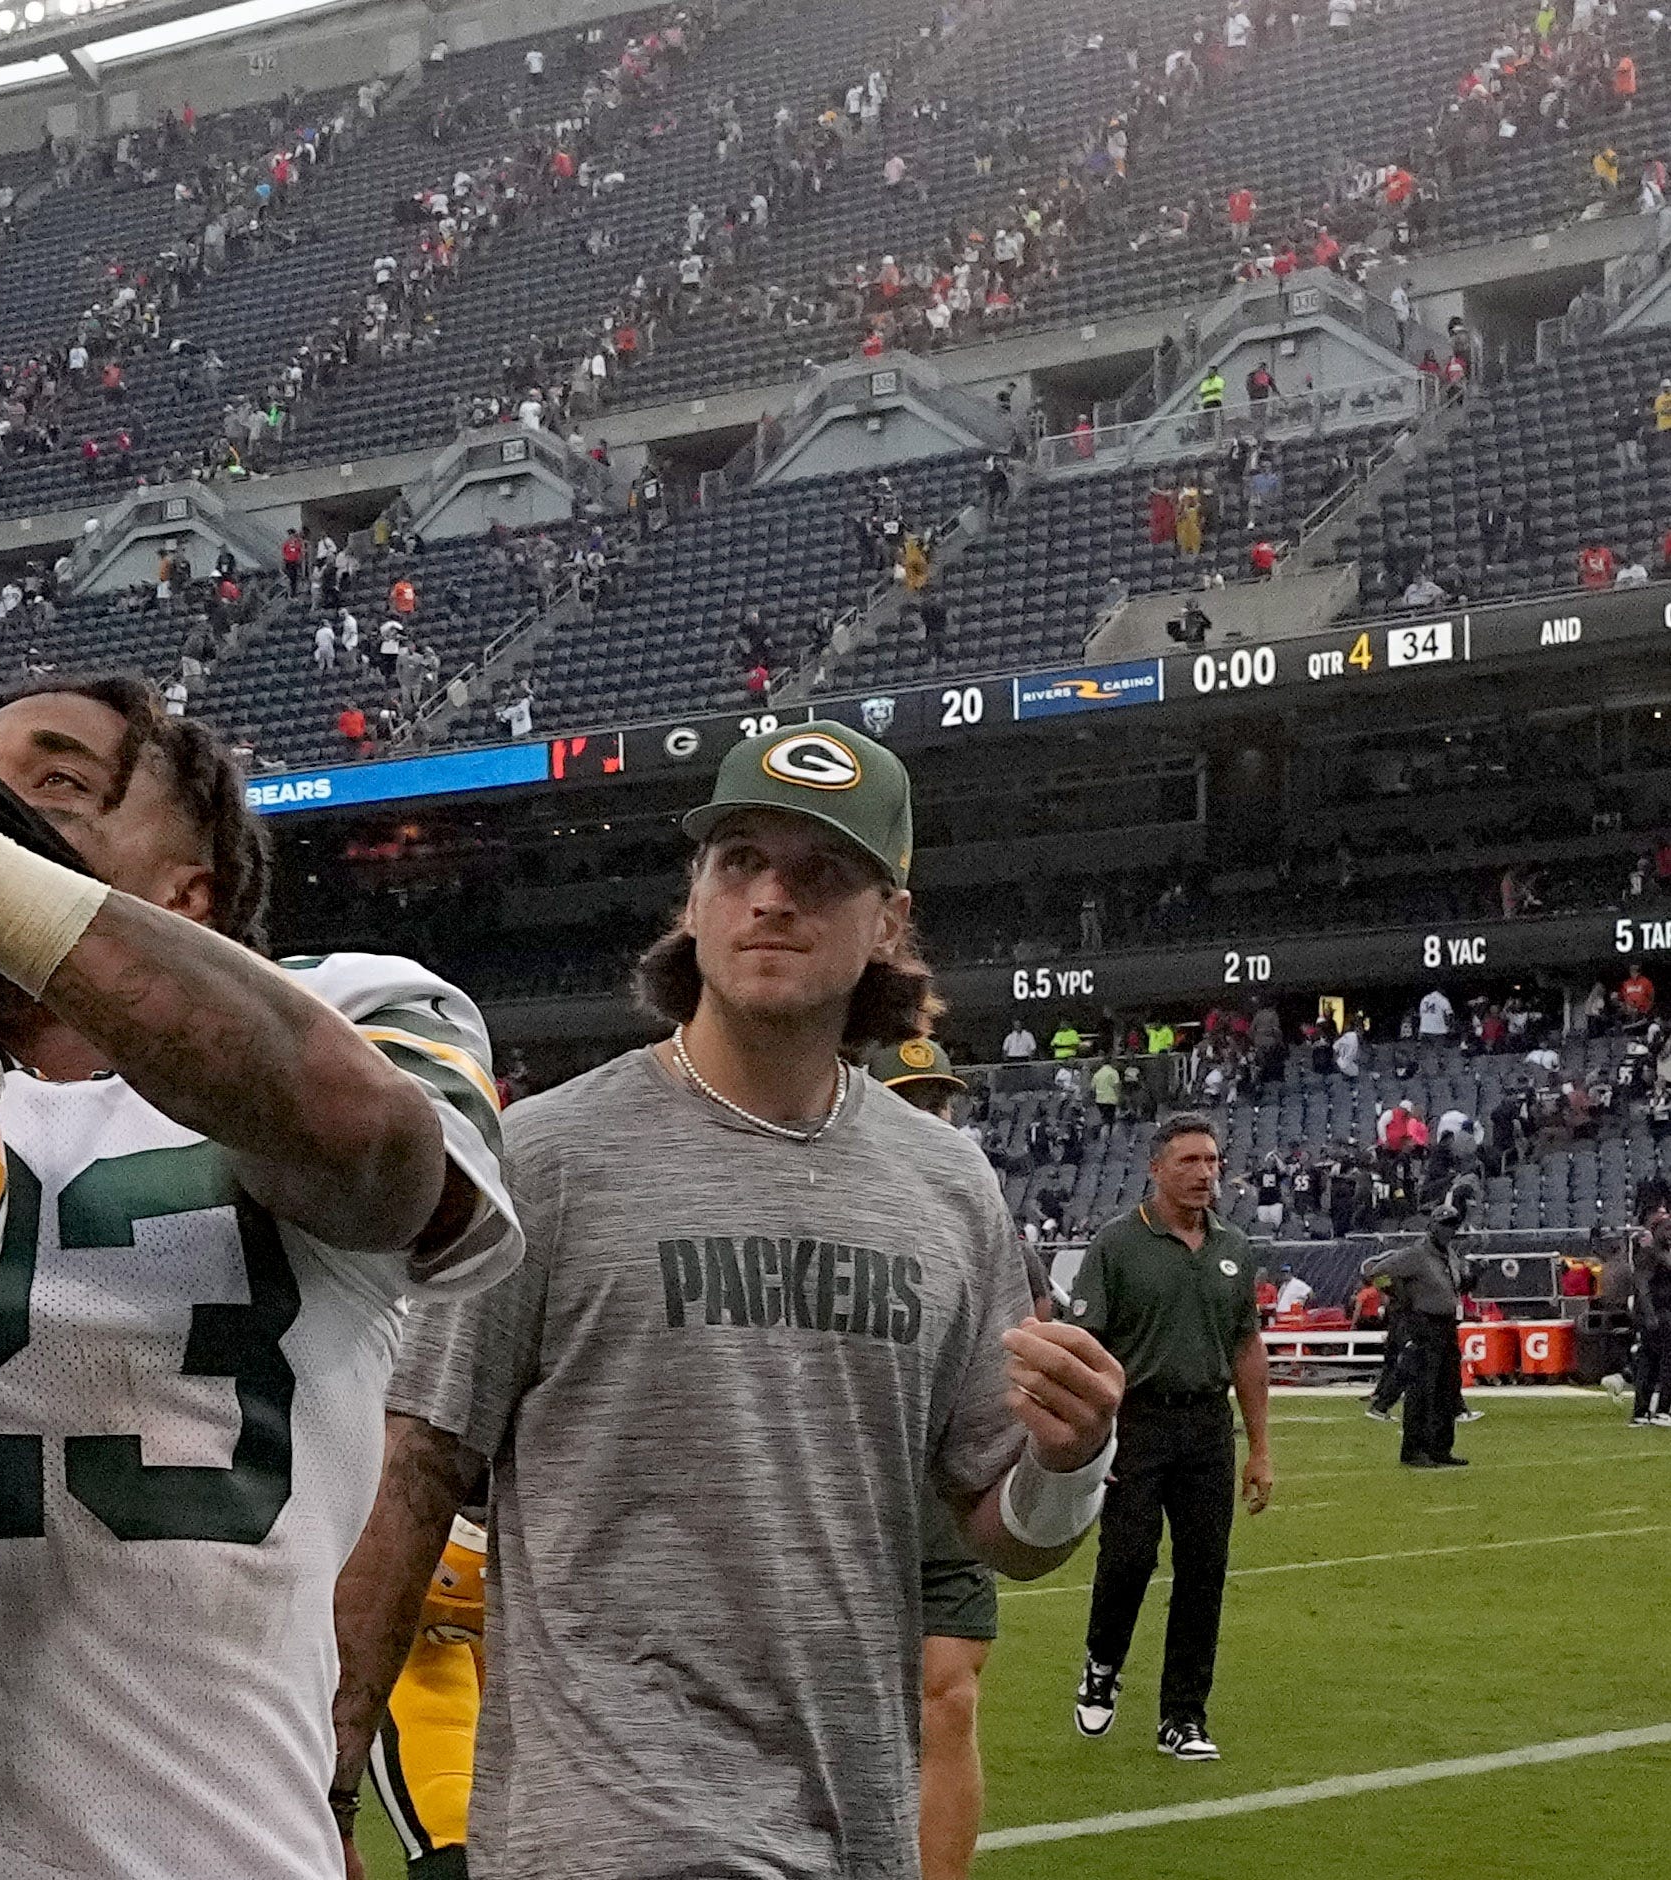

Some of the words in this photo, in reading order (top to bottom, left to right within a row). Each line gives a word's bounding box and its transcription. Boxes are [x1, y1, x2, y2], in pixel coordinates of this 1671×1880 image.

[1540, 617, 1582, 646] AND
[1193, 646, 1277, 694] 0:00
[1308, 650, 1345, 680] QTR
[1348, 632, 1373, 671] 4
[1403, 631, 1439, 660] 34
[1022, 685, 1072, 702] RIVERS
[1102, 676, 1154, 692] CASINO
[941, 687, 984, 726] 20
[247, 779, 332, 808] BEARS
[1424, 935, 1442, 968] 8
[1448, 937, 1488, 966] YAC
[1615, 919, 1635, 953] 5
[1013, 967, 1053, 1001] 6.5
[1056, 970, 1095, 996] YPC
[1224, 951, 1241, 984] 2
[1246, 954, 1272, 981] TD
[658, 1237, 923, 1345] PACKERS
